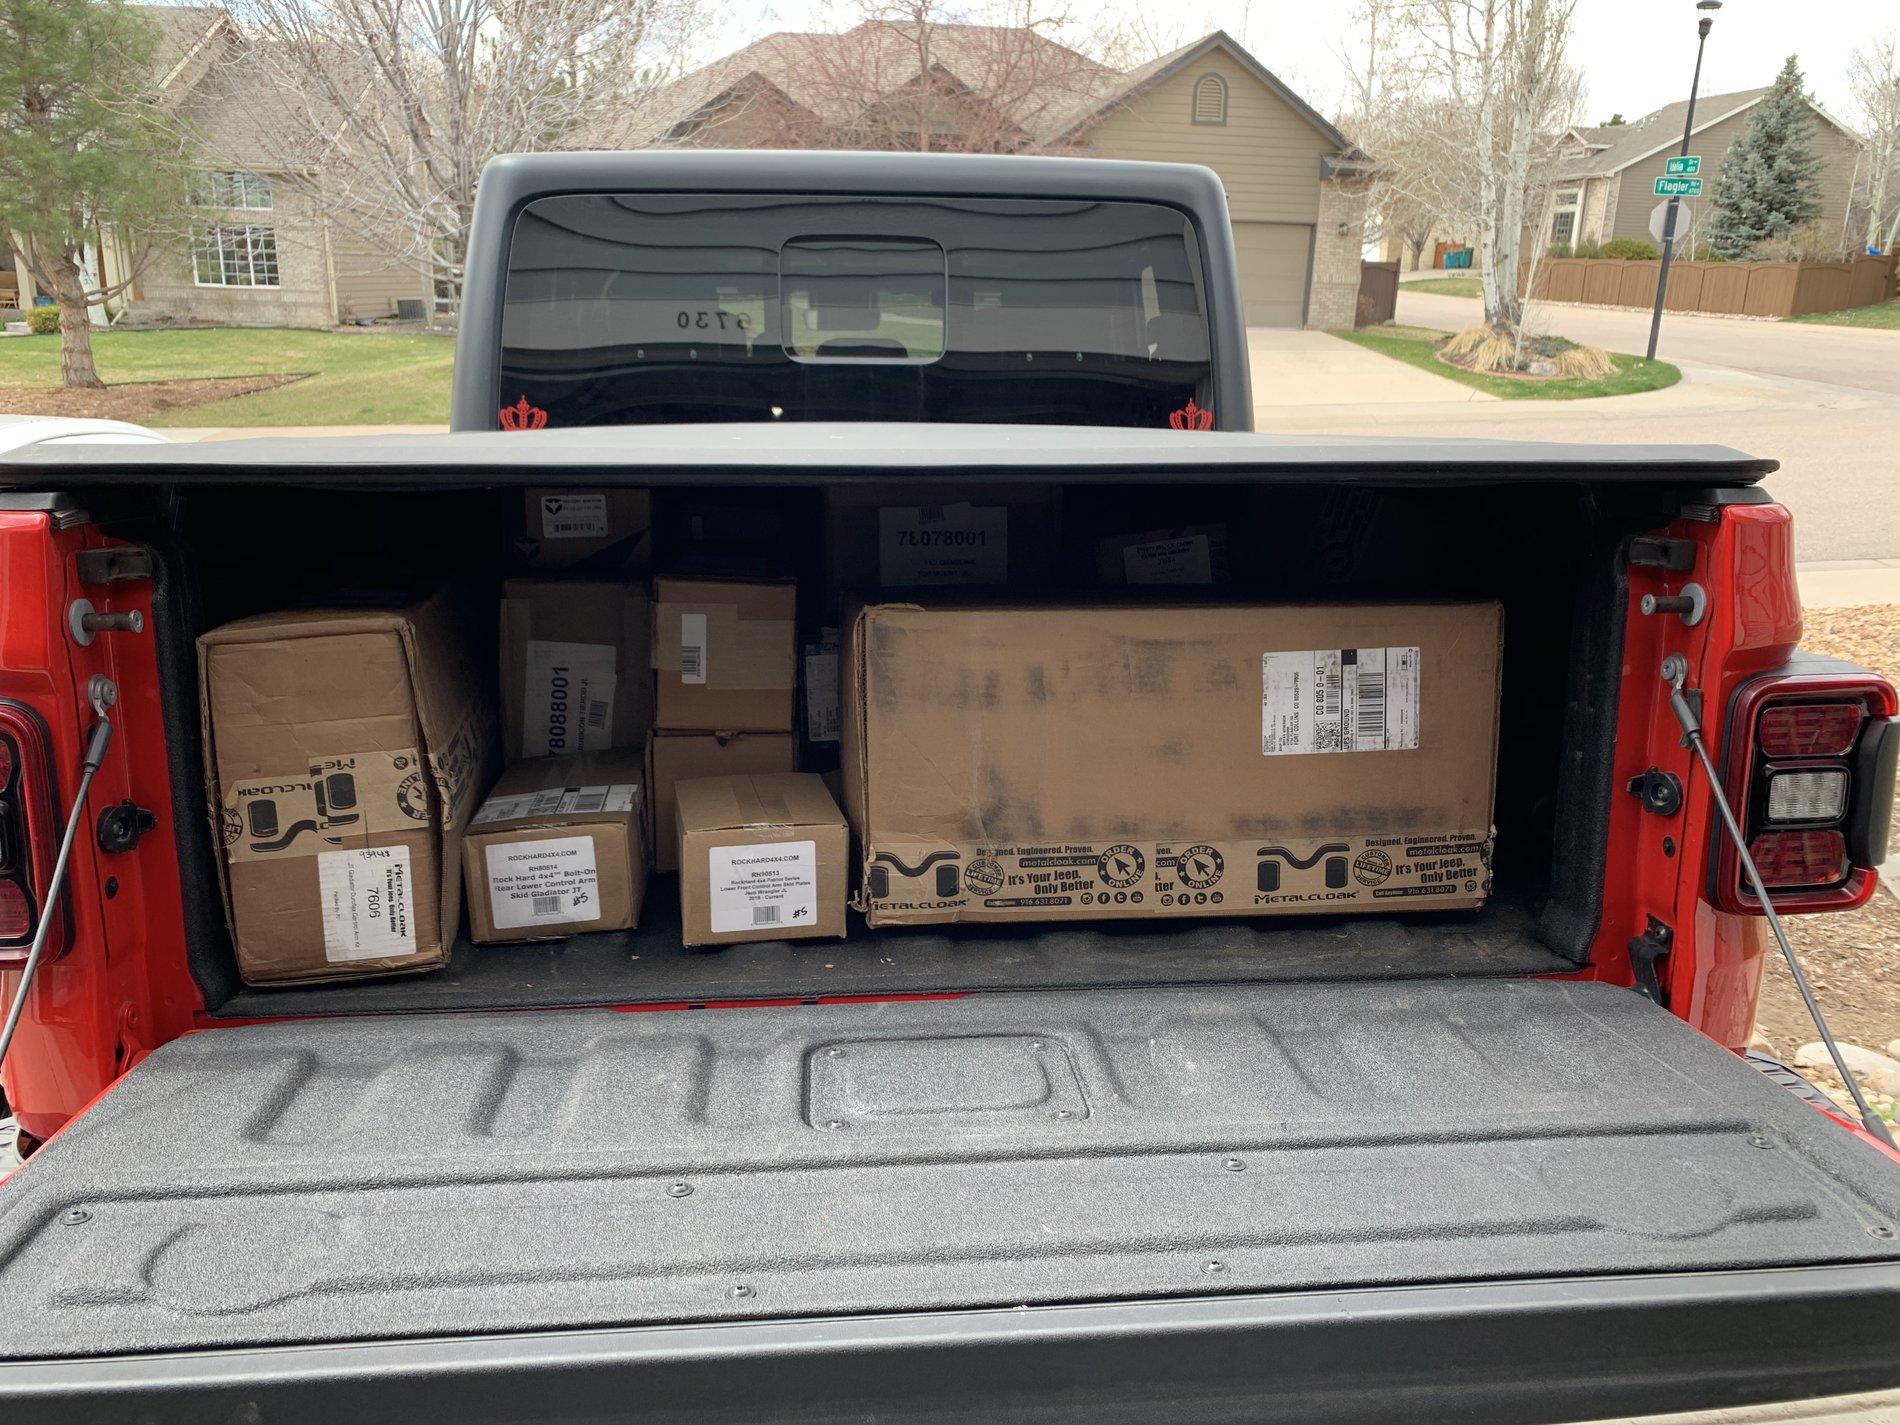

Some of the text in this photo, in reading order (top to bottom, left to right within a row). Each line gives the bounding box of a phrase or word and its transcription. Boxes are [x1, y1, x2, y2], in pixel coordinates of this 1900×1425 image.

[1659, 180, 1689, 194] Flagler
[1316, 689, 1325, 703] 805
[1316, 705, 1325, 715] CO
[1365, 834, 1476, 847] Designed. Engineered. Proven.
[508, 850, 577, 861] ROCKHARD4X4.COM
[1017, 847, 1063, 856] Engineered.
[1065, 845, 1094, 854] Proven.
[1101, 845, 1134, 863] ORDER
[1180, 846, 1213, 864] ORDER
[1409, 845, 1479, 856] metalcloak.com
[732, 855, 799, 865] ROCKHARD4X4.COM
[1022, 857, 1096, 867] metalcloak.com
[1355, 861, 1391, 875] LIFETIME
[1395, 864, 1412, 875] It's
[1414, 861, 1438, 872] Your
[1421, 867, 1478, 883] Only Better
[493, 875, 514, 883] Rock
[515, 874, 536, 882] Hard
[564, 868, 596, 877] Bolt-On
[1008, 875, 1025, 885] It's
[1027, 872, 1053, 883] Your
[1108, 869, 1144, 888] ONLINE
[1188, 870, 1223, 889] ONLINE
[517, 882, 542, 890] Lower
[545, 879, 576, 888] Control
[1034, 880, 1094, 895] Only Better
[510, 891, 529, 899] Skid
[531, 888, 570, 897] Gladiator
[366, 887, 381, 918] 7606
